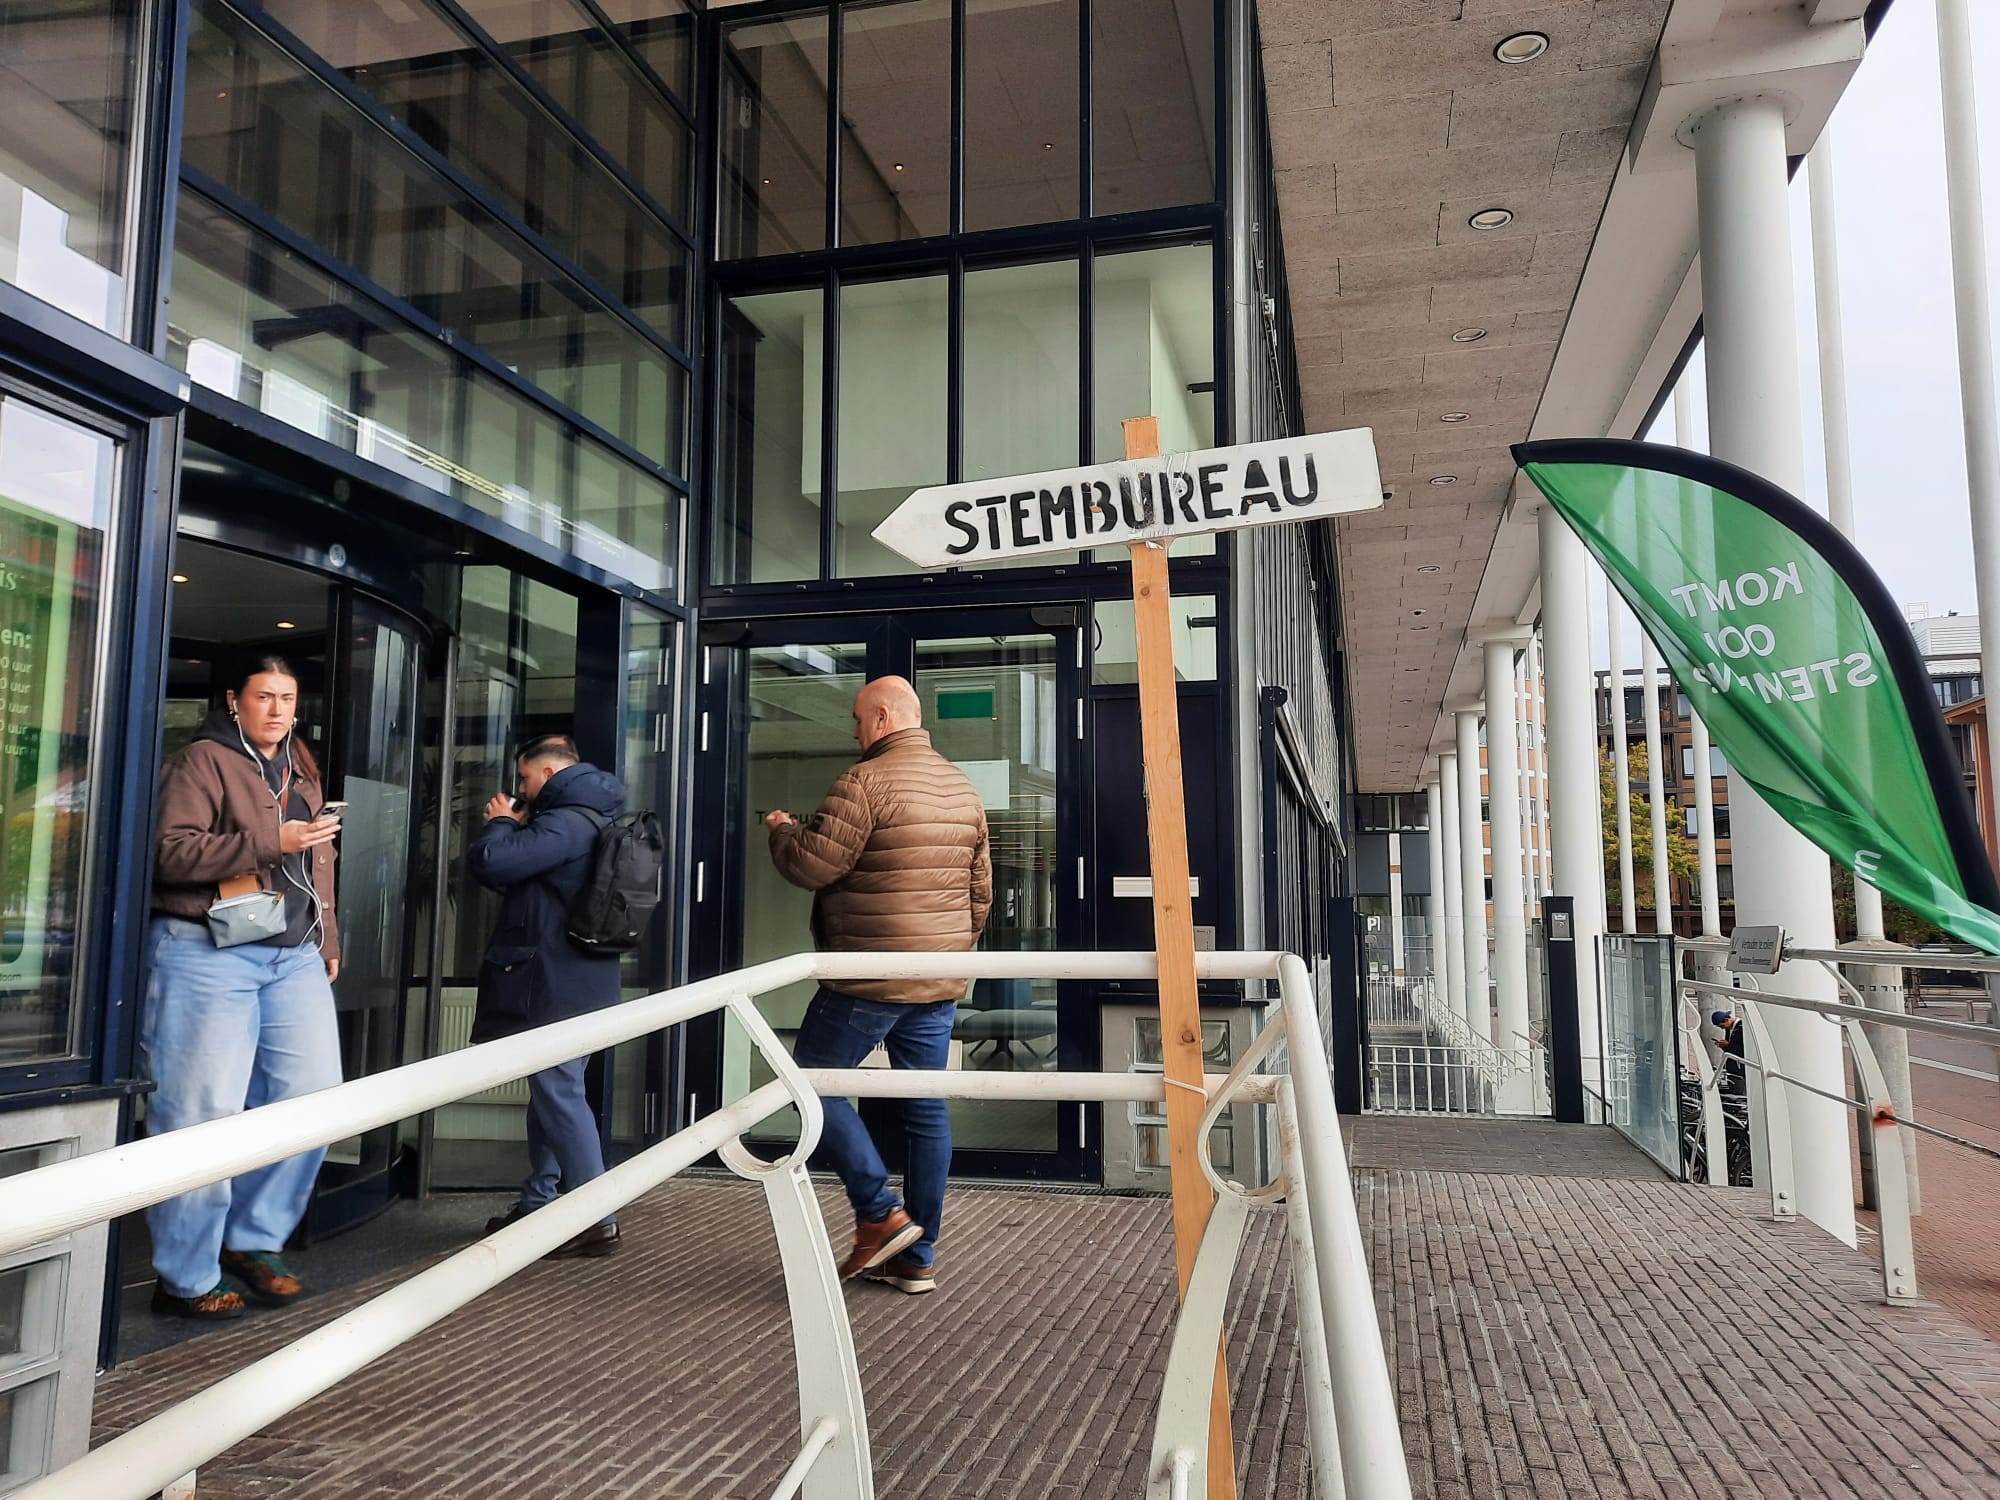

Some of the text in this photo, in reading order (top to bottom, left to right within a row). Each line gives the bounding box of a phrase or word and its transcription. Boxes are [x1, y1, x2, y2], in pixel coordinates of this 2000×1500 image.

[944, 453, 1318, 555] STEMBUREAU
[12, 661, 32, 673] uur
[10, 682, 31, 694] uur
[8, 702, 29, 714] uur
